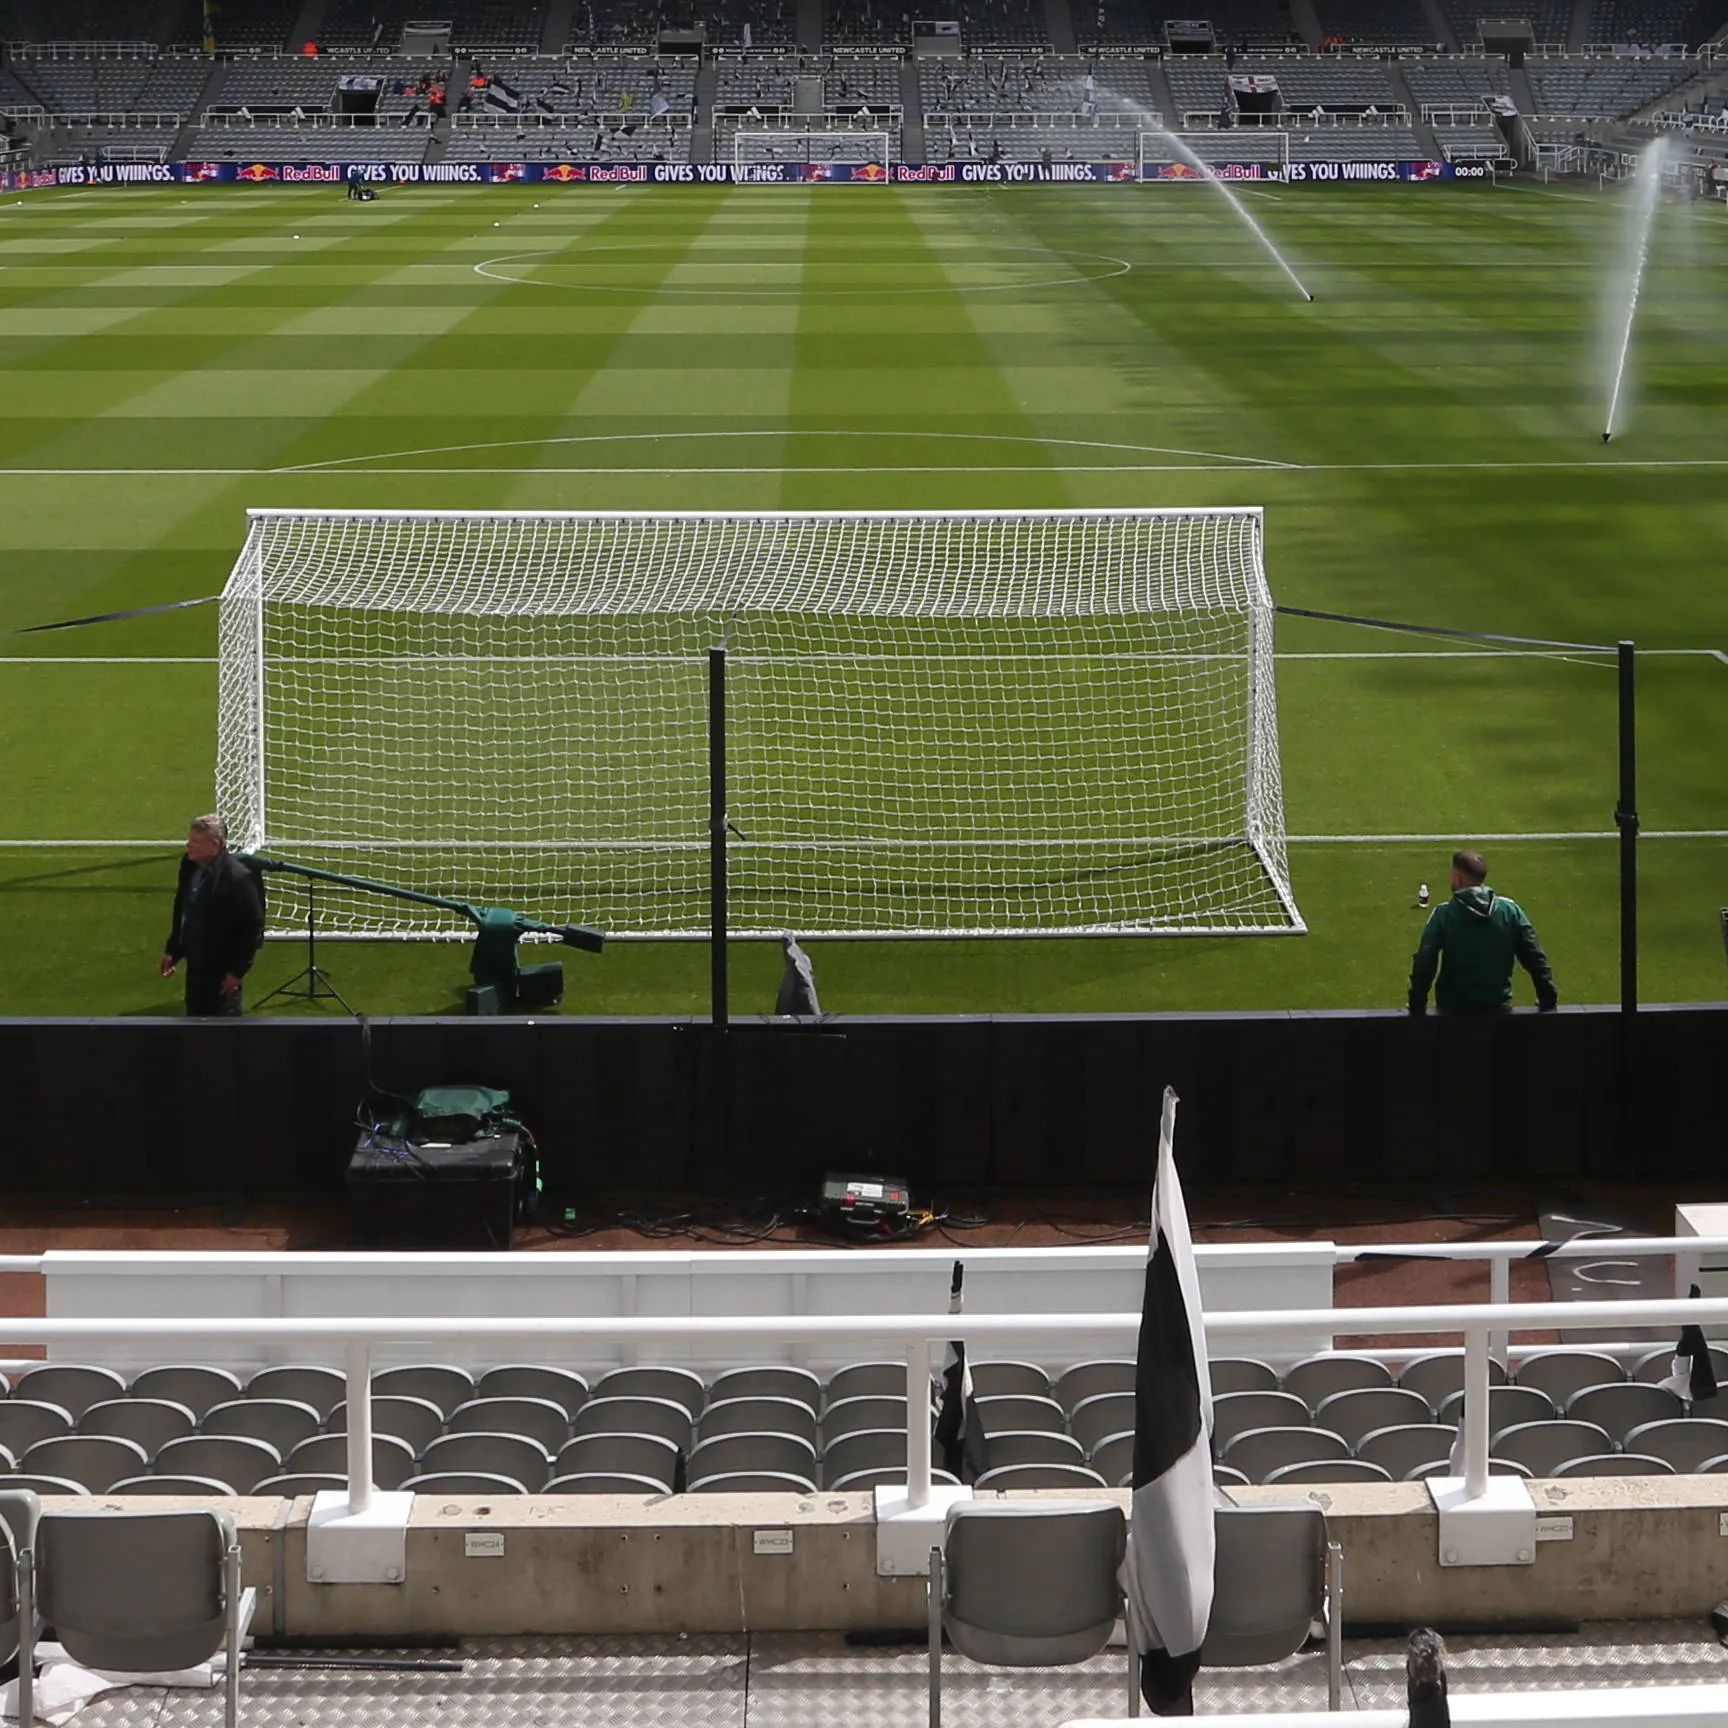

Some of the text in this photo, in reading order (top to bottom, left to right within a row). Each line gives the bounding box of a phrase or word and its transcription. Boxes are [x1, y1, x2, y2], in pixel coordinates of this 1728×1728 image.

[59, 166, 84, 184] GIVES
[283, 165, 339, 181] Red Bull
[387, 164, 419, 181] YOU
[423, 164, 481, 181] WIIINGS.
[590, 165, 647, 181] Red Bull
[654, 165, 693, 181] GIVES
[696, 165, 725, 181] YOU
[897, 165, 926, 181] Red
[962, 164, 1001, 181] GIVES
[1004, 164, 1034, 181] YOU
[1233, 164, 1261, 179] Bull
[1309, 163, 1338, 180] YOU
[1341, 163, 1400, 180] WIIINGS.
[1455, 166, 1484, 177] 00:00
